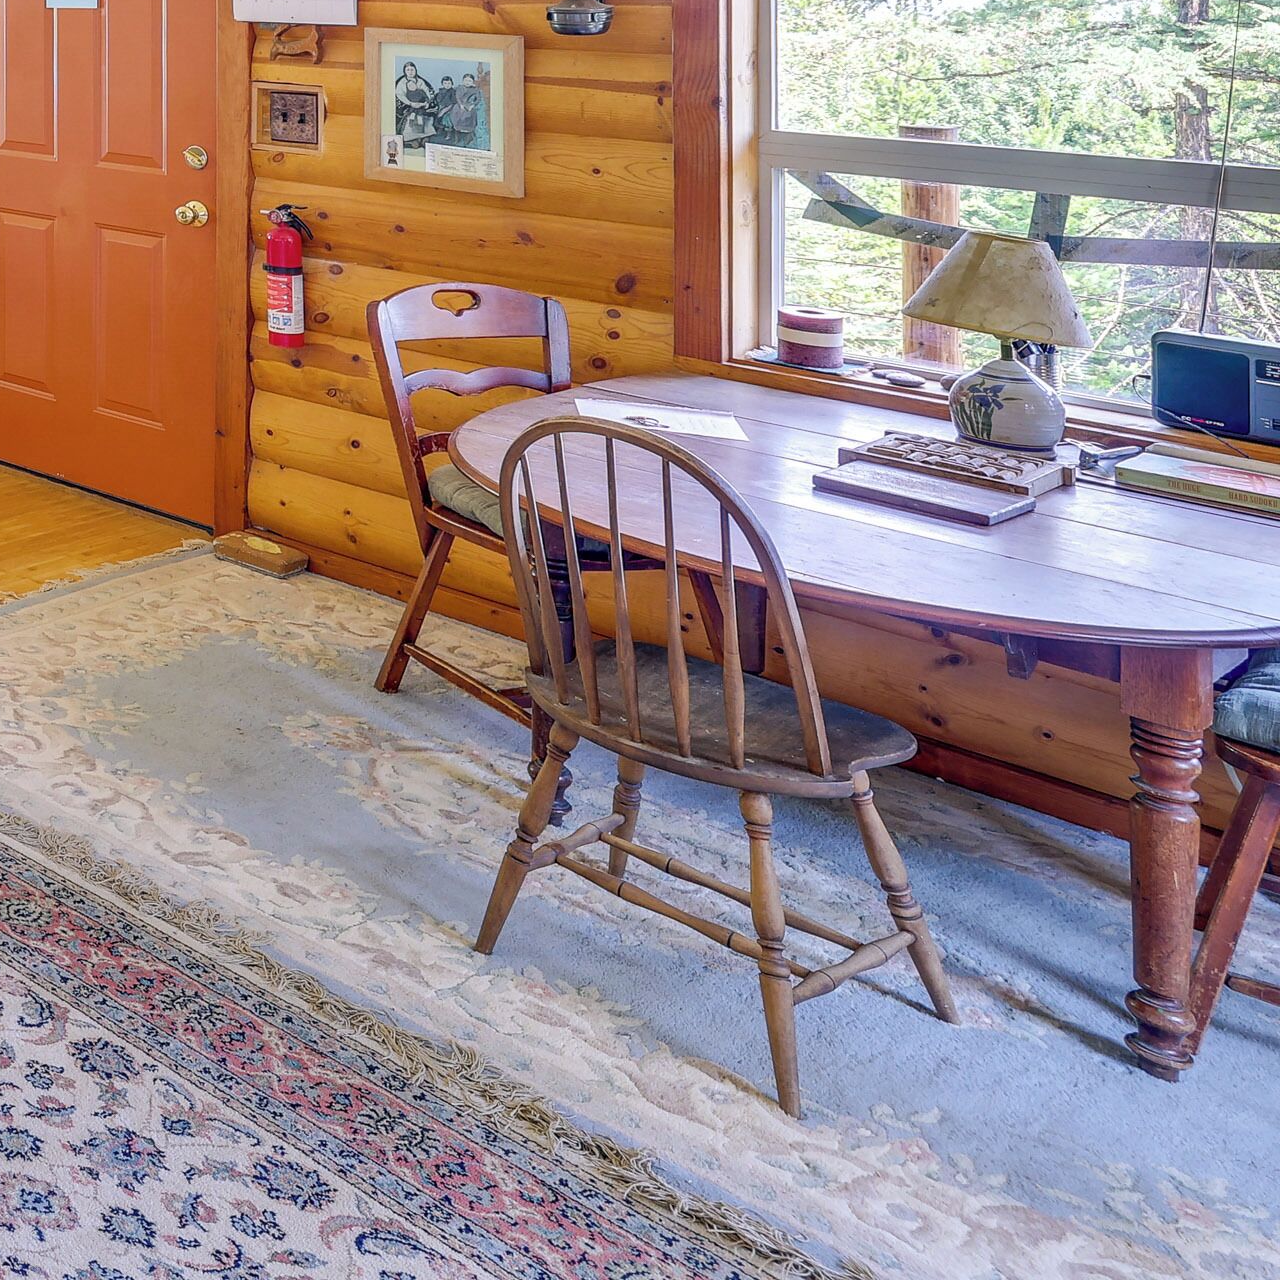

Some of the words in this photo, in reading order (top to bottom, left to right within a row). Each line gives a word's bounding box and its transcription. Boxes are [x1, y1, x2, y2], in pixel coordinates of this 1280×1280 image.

[1167, 480, 1181, 490] THE
[1228, 491, 1249, 502] HARD
[1249, 495, 1278, 508] SUDOKU
